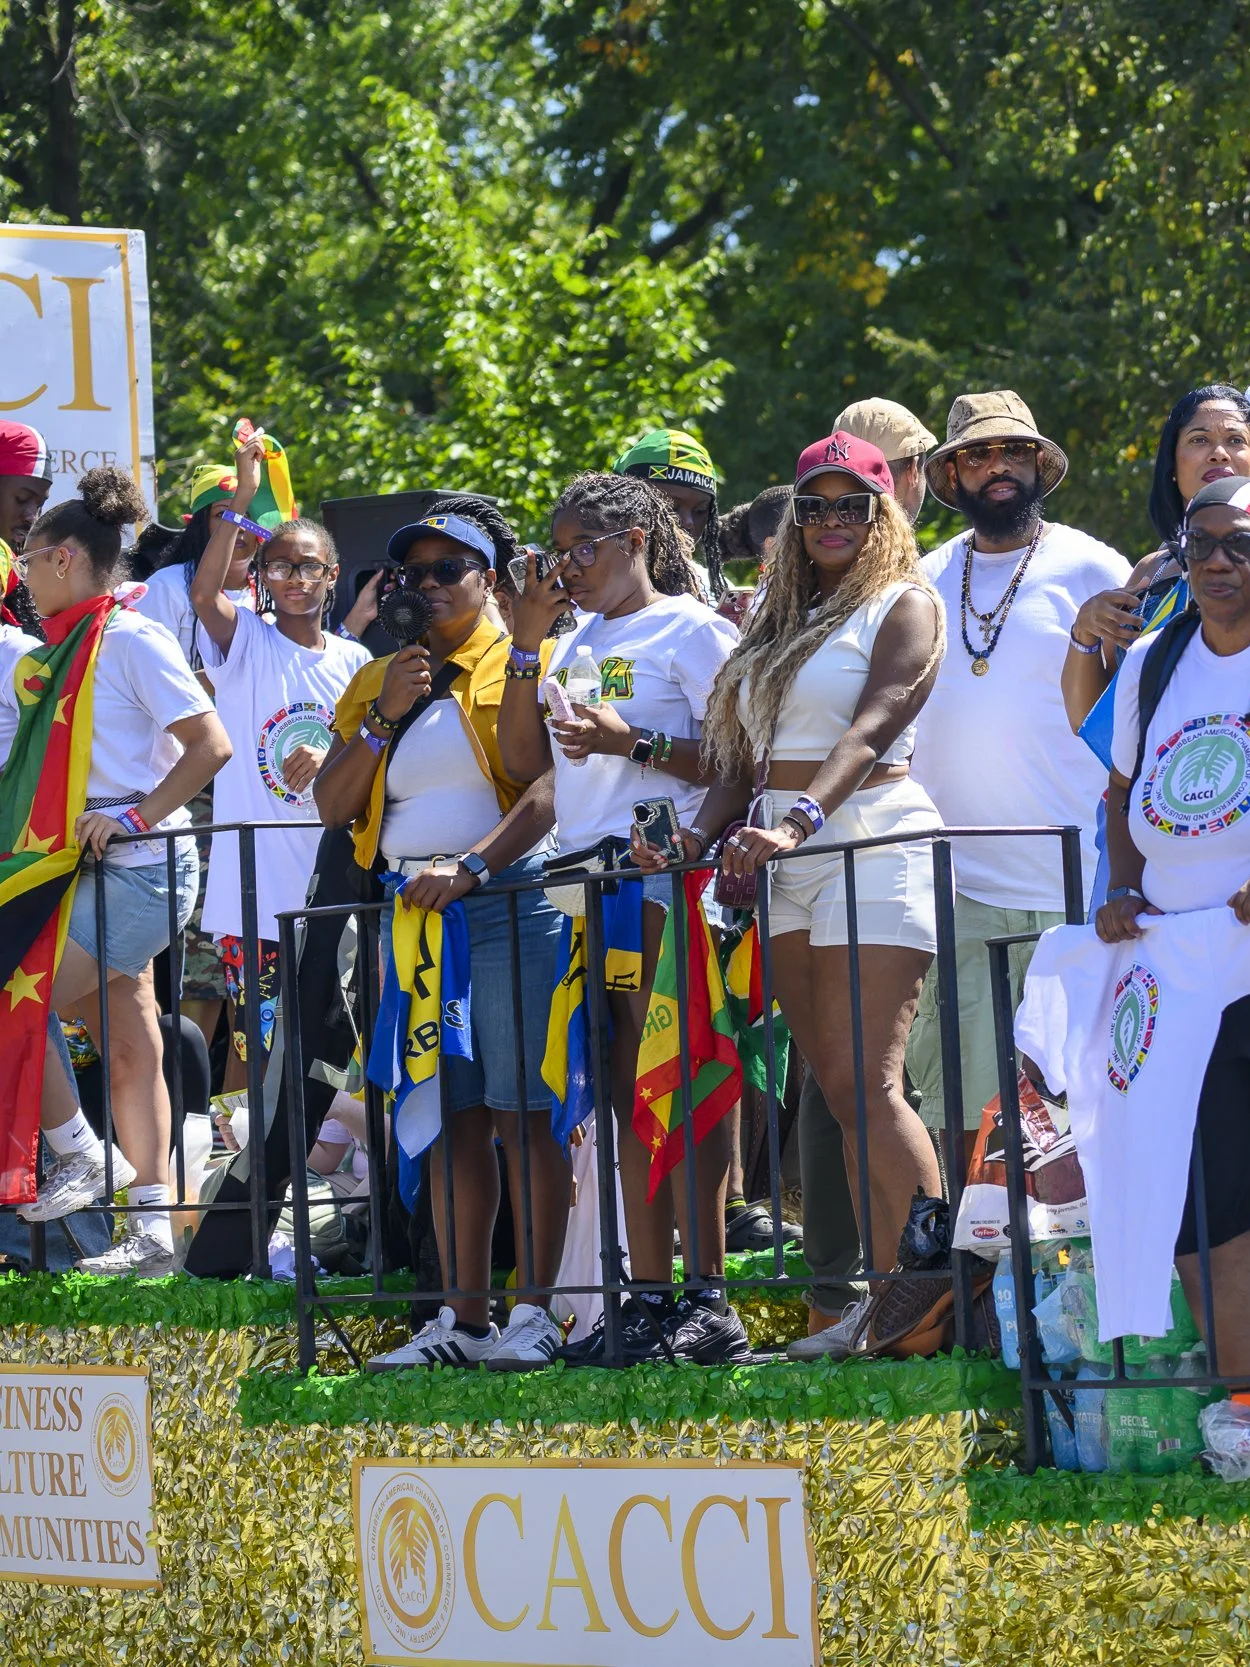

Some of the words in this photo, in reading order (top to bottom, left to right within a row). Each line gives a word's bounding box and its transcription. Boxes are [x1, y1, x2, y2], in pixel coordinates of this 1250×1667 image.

[667, 468, 716, 491] JAMAICA
[274, 716, 303, 737] CARIBBEAN
[1203, 729, 1238, 740] AMERICAN
[1166, 732, 1202, 763] CARIBBEAN
[1157, 765, 1169, 779] THE
[1183, 790, 1214, 802] CACCI
[1211, 781, 1248, 814] COMMERCE
[1160, 802, 1191, 822] INDUSTRY
[1192, 813, 1210, 821] AND
[0, 1385, 83, 1432] INESS
[416, 1486, 441, 1523] CHAMBER
[439, 1524, 447, 1539] OF
[463, 1493, 799, 1640] CACCI
[401, 1590, 425, 1604] CACCI
